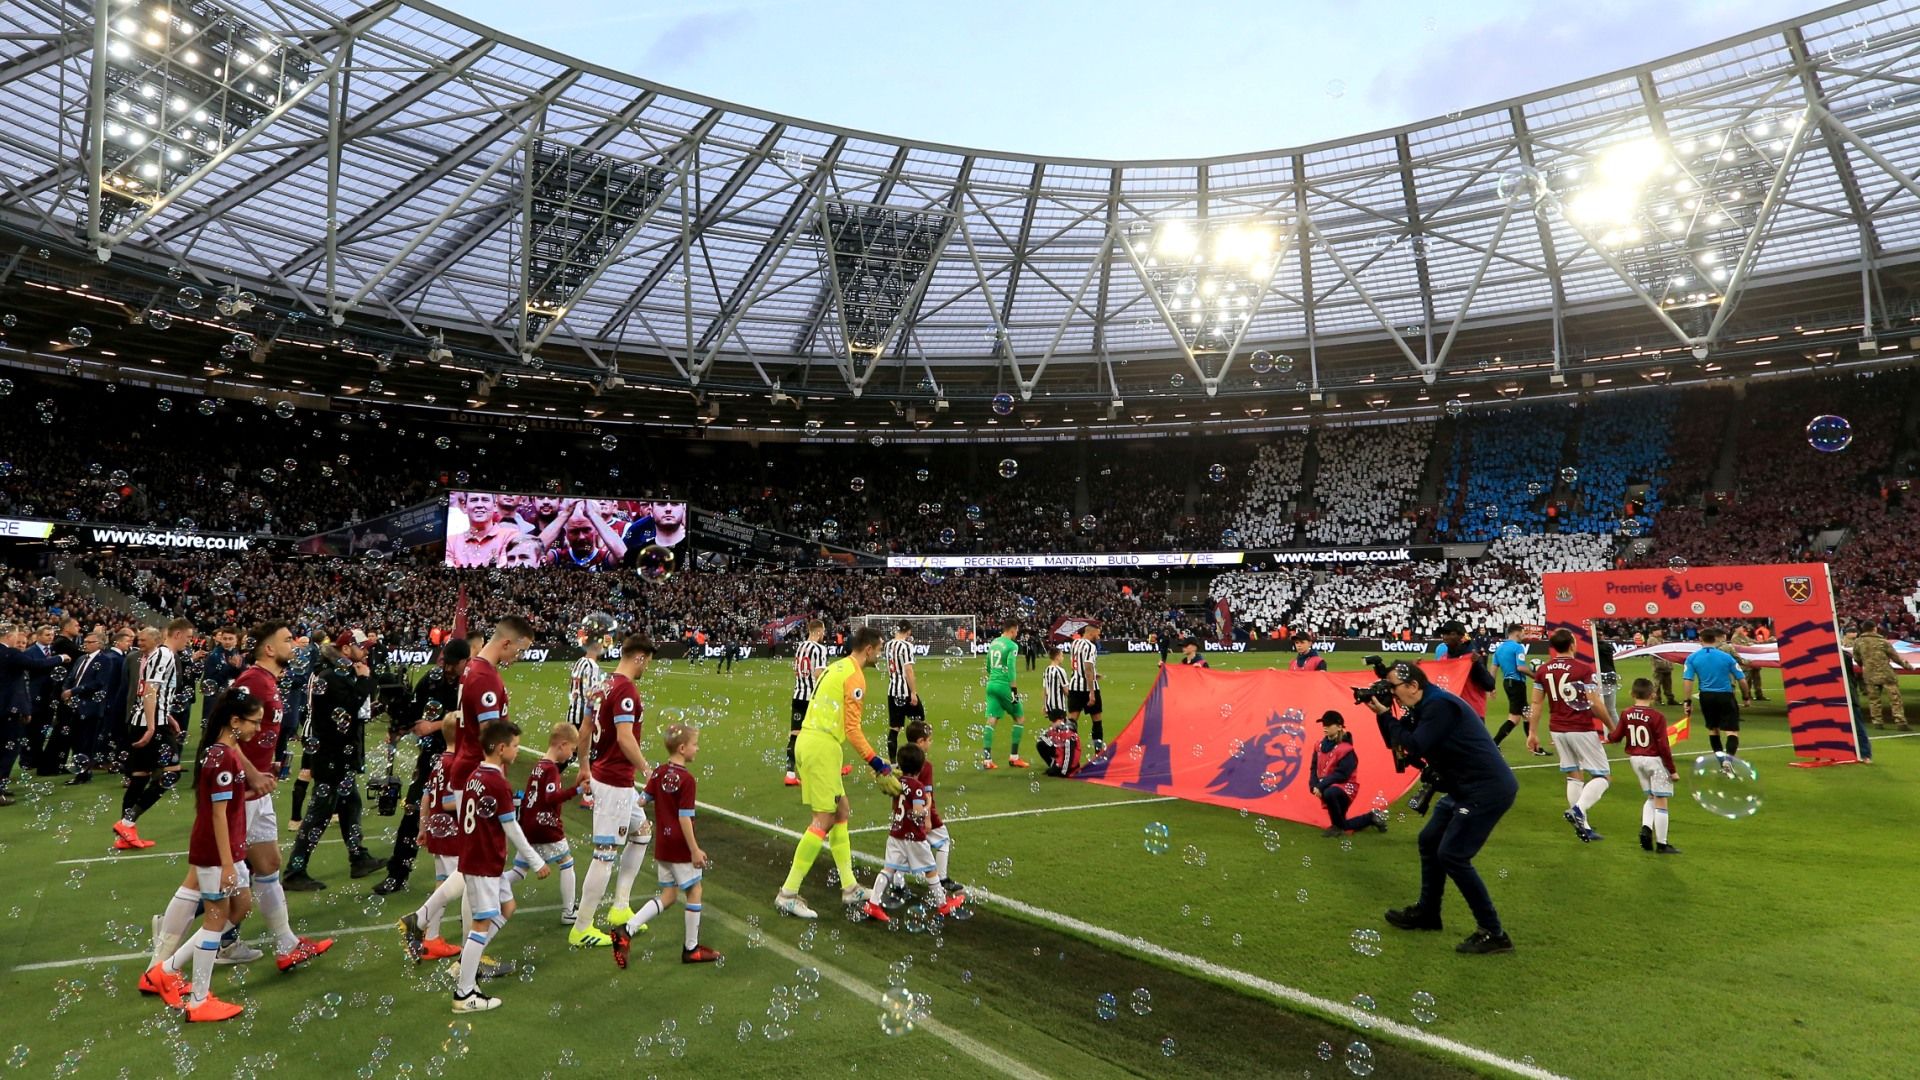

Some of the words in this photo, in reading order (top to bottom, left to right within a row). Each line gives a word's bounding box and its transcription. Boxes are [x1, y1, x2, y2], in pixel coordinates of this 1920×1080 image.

[449, 412, 495, 426] BOBBY
[498, 416, 548, 429] MOORE
[549, 421, 593, 432] STAND
[93, 529, 249, 550] www.schore.co.uk
[964, 557, 1034, 566] REGENERATE
[1045, 556, 1097, 566] MAINTAIN
[1108, 556, 1139, 565] BUILD
[1274, 548, 1410, 563] www.schore.co.uk
[1606, 582, 1657, 594] Premier
[1685, 579, 1743, 595] League
[1382, 640, 1428, 653] betway
[990, 650, 1003, 668] 12
[1547, 663, 1572, 671] NOBLE
[1545, 672, 1578, 702] 16
[1626, 712, 1650, 722] MILLS
[1627, 724, 1650, 748] 10
[466, 779, 486, 796] LOUIE
[464, 797, 476, 834] 8
[895, 793, 906, 822] 5
